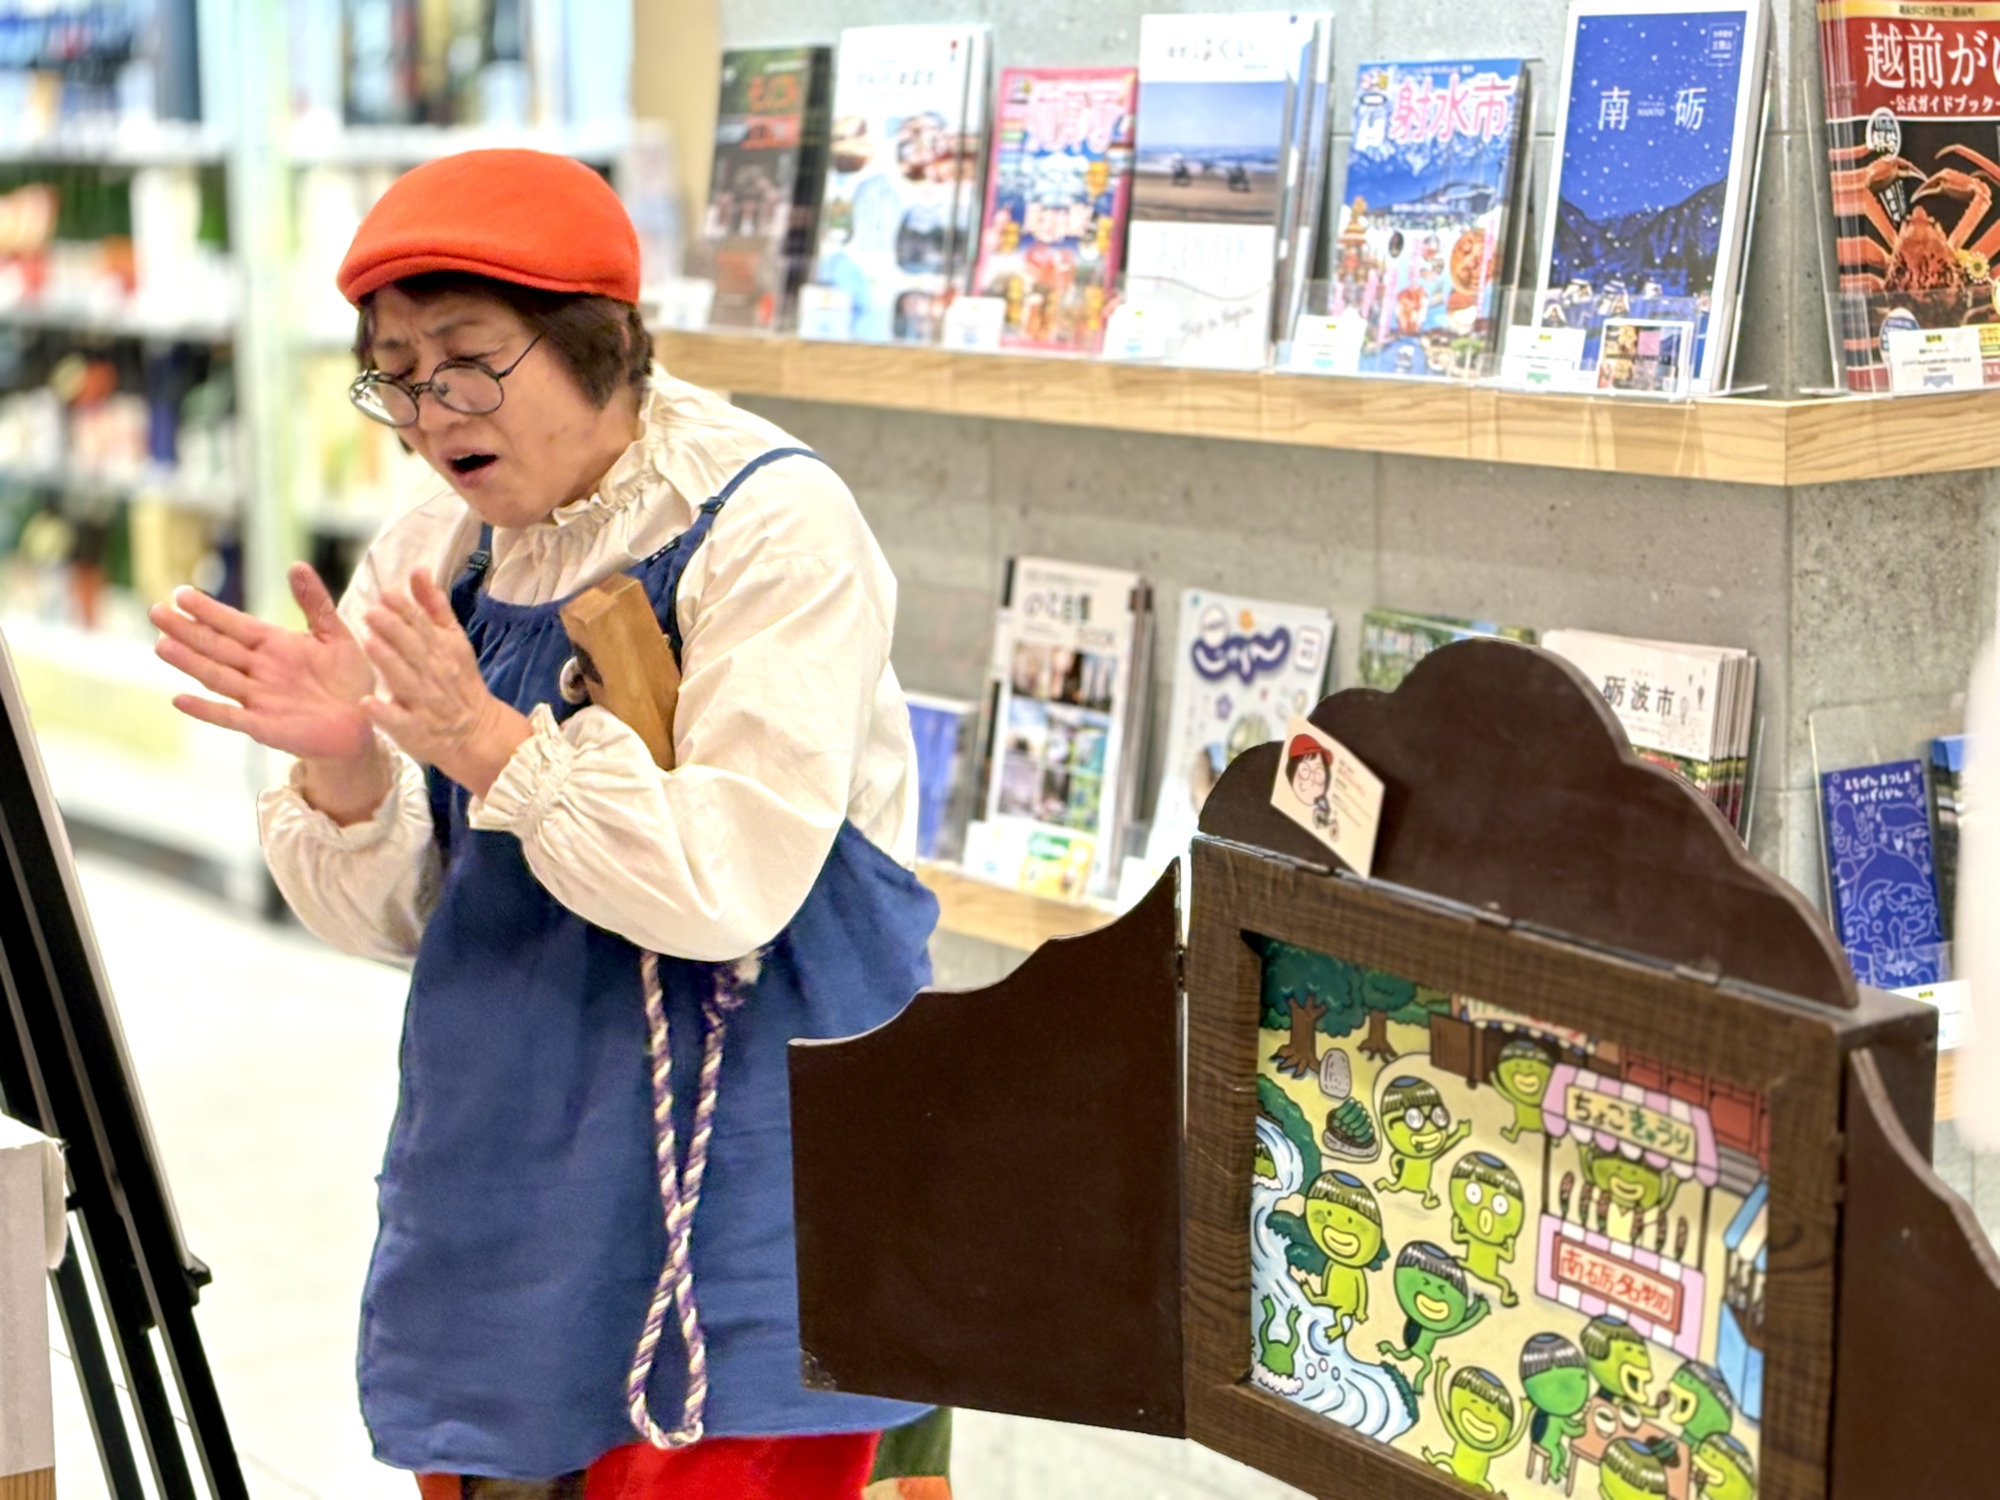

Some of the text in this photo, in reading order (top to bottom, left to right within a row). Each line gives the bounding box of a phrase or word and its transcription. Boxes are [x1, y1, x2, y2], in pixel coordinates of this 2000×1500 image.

[1863, 21, 2000, 89] 越前が
[1390, 73, 1513, 141] 射水市
[1572, 1091, 1691, 1155] ちょこきゅうり
